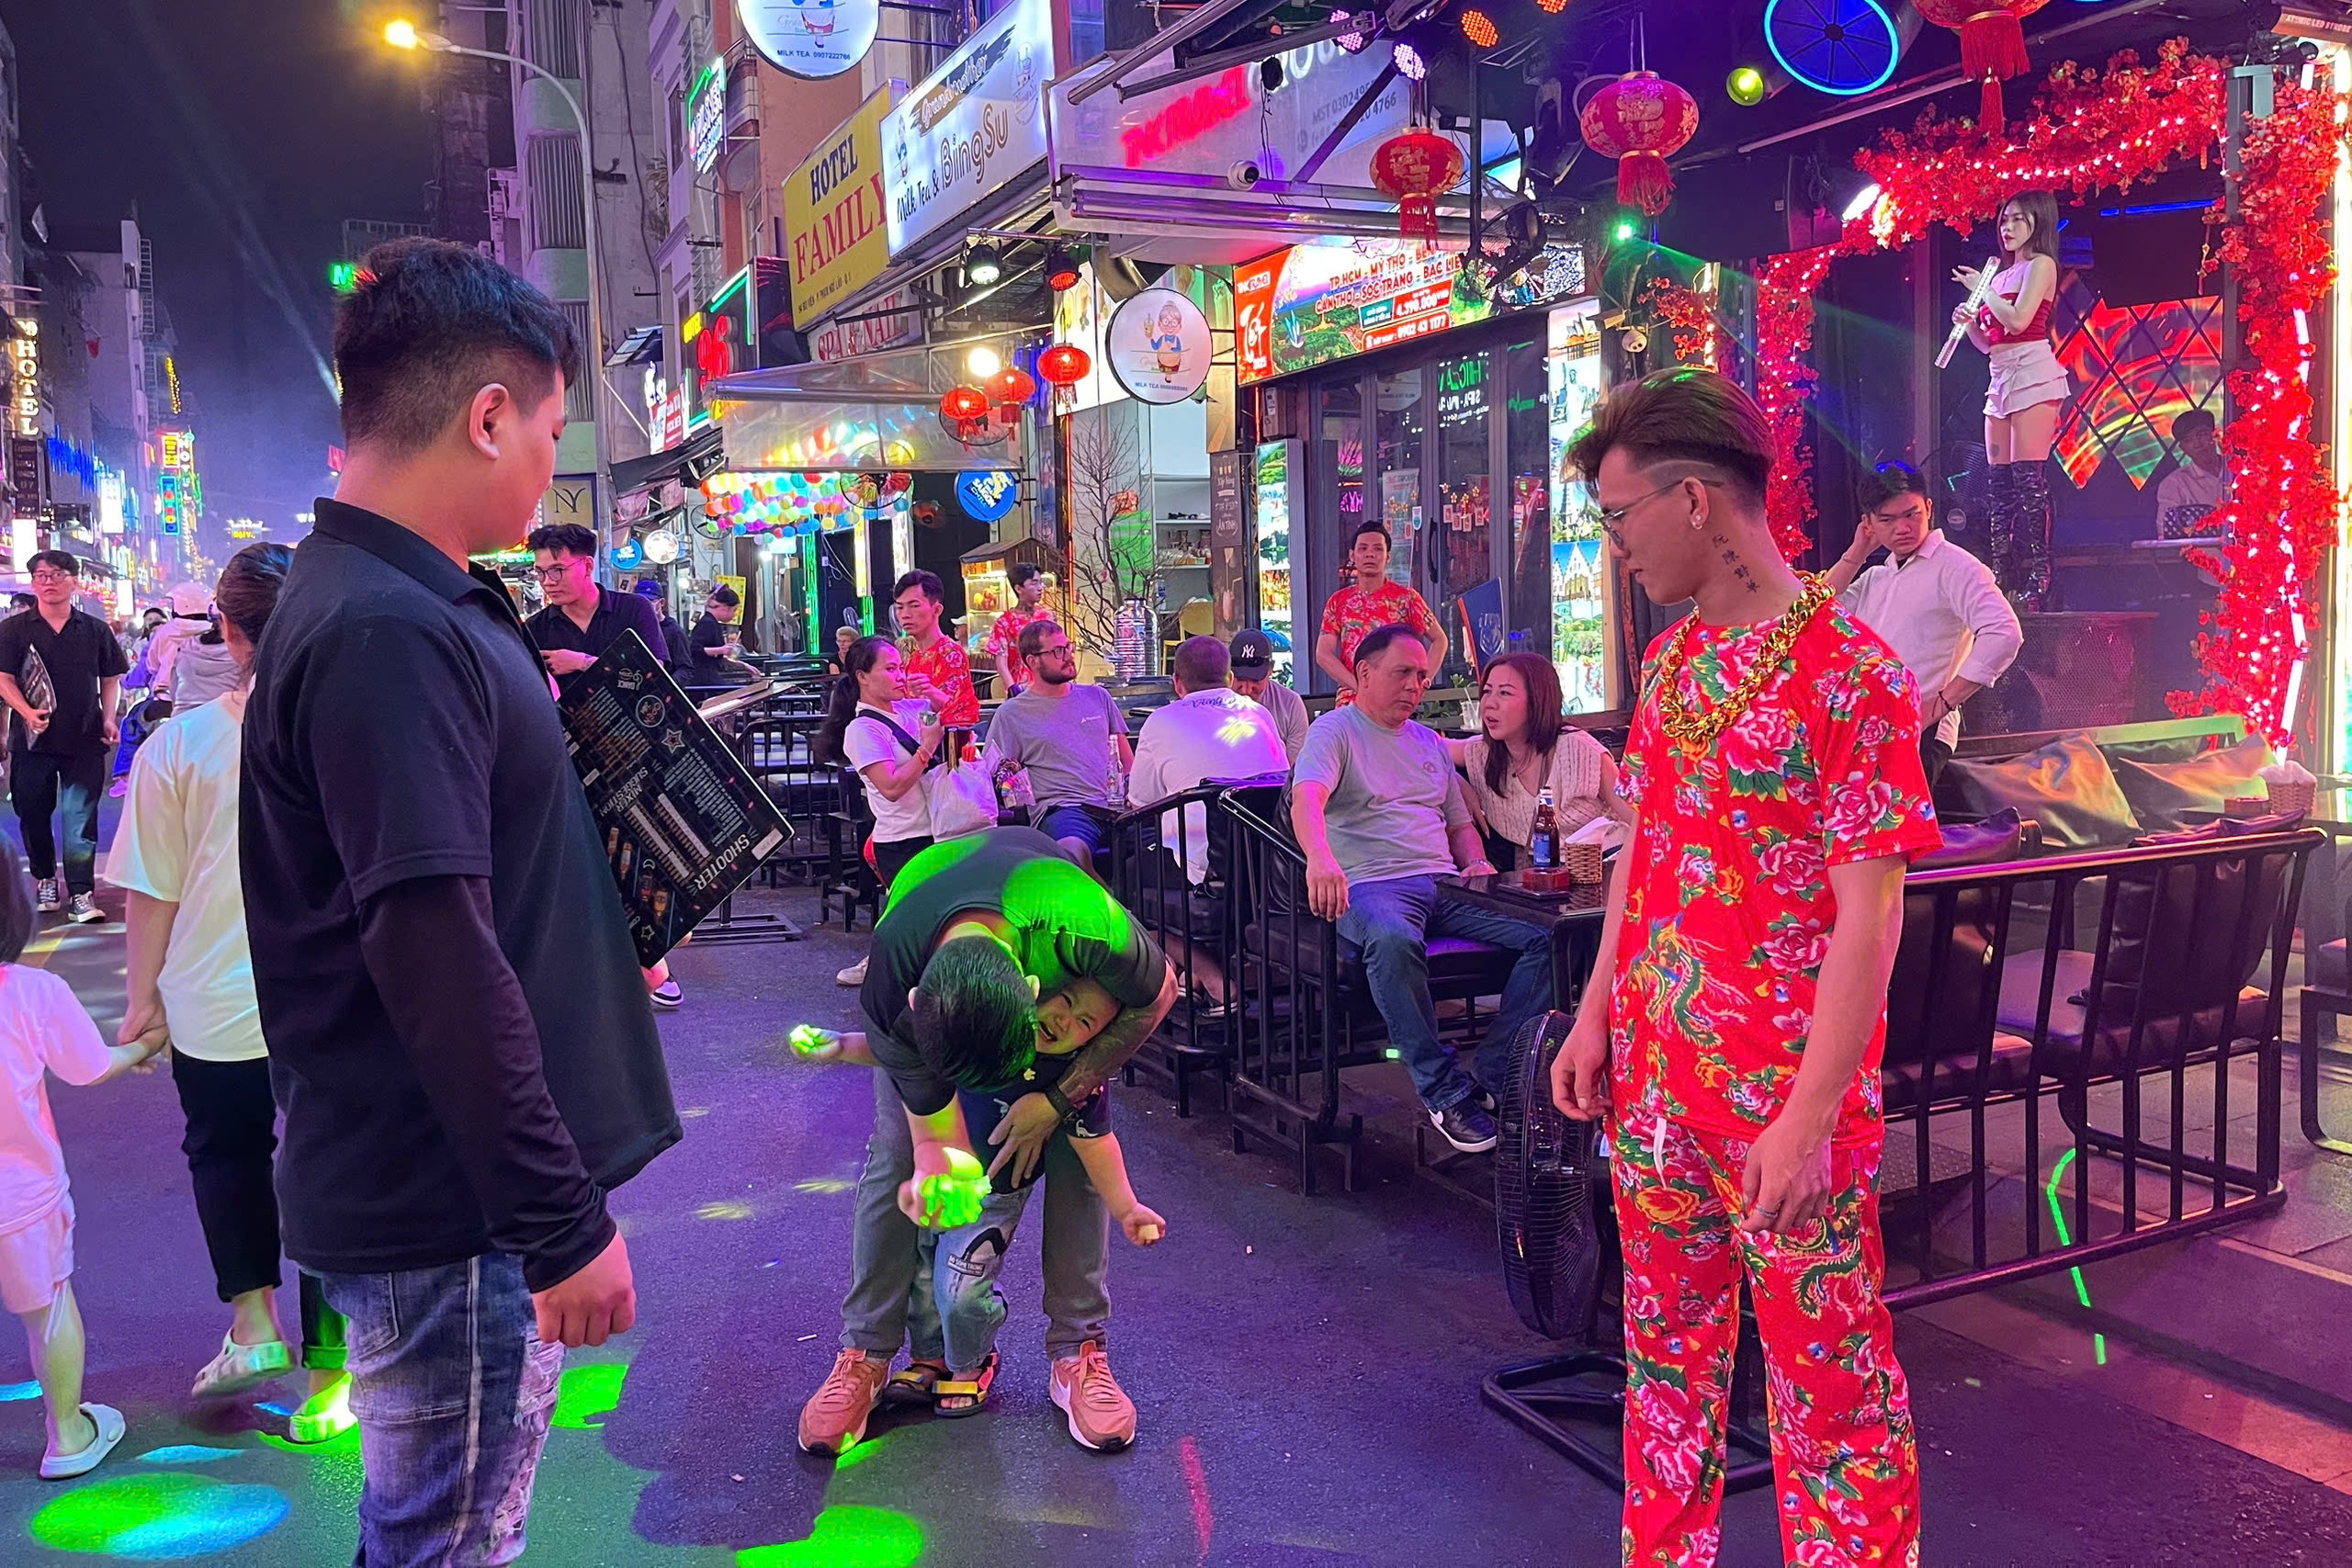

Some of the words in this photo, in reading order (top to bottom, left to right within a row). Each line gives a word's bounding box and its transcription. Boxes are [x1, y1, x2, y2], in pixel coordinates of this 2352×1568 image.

[2312, 18, 2325, 28] LED
[1372, 91, 1397, 116] 4766
[809, 133, 858, 206] HOTEL
[794, 171, 888, 285] FAMILY
[897, 186, 917, 224] Milk
[918, 180, 932, 208] Tea
[697, 314, 730, 382] 96
[818, 325, 843, 362] SPA
[17, 339, 40, 436] HOTEL
[1241, 644, 1255, 658] NY
[692, 831, 752, 891] SHOOTER
